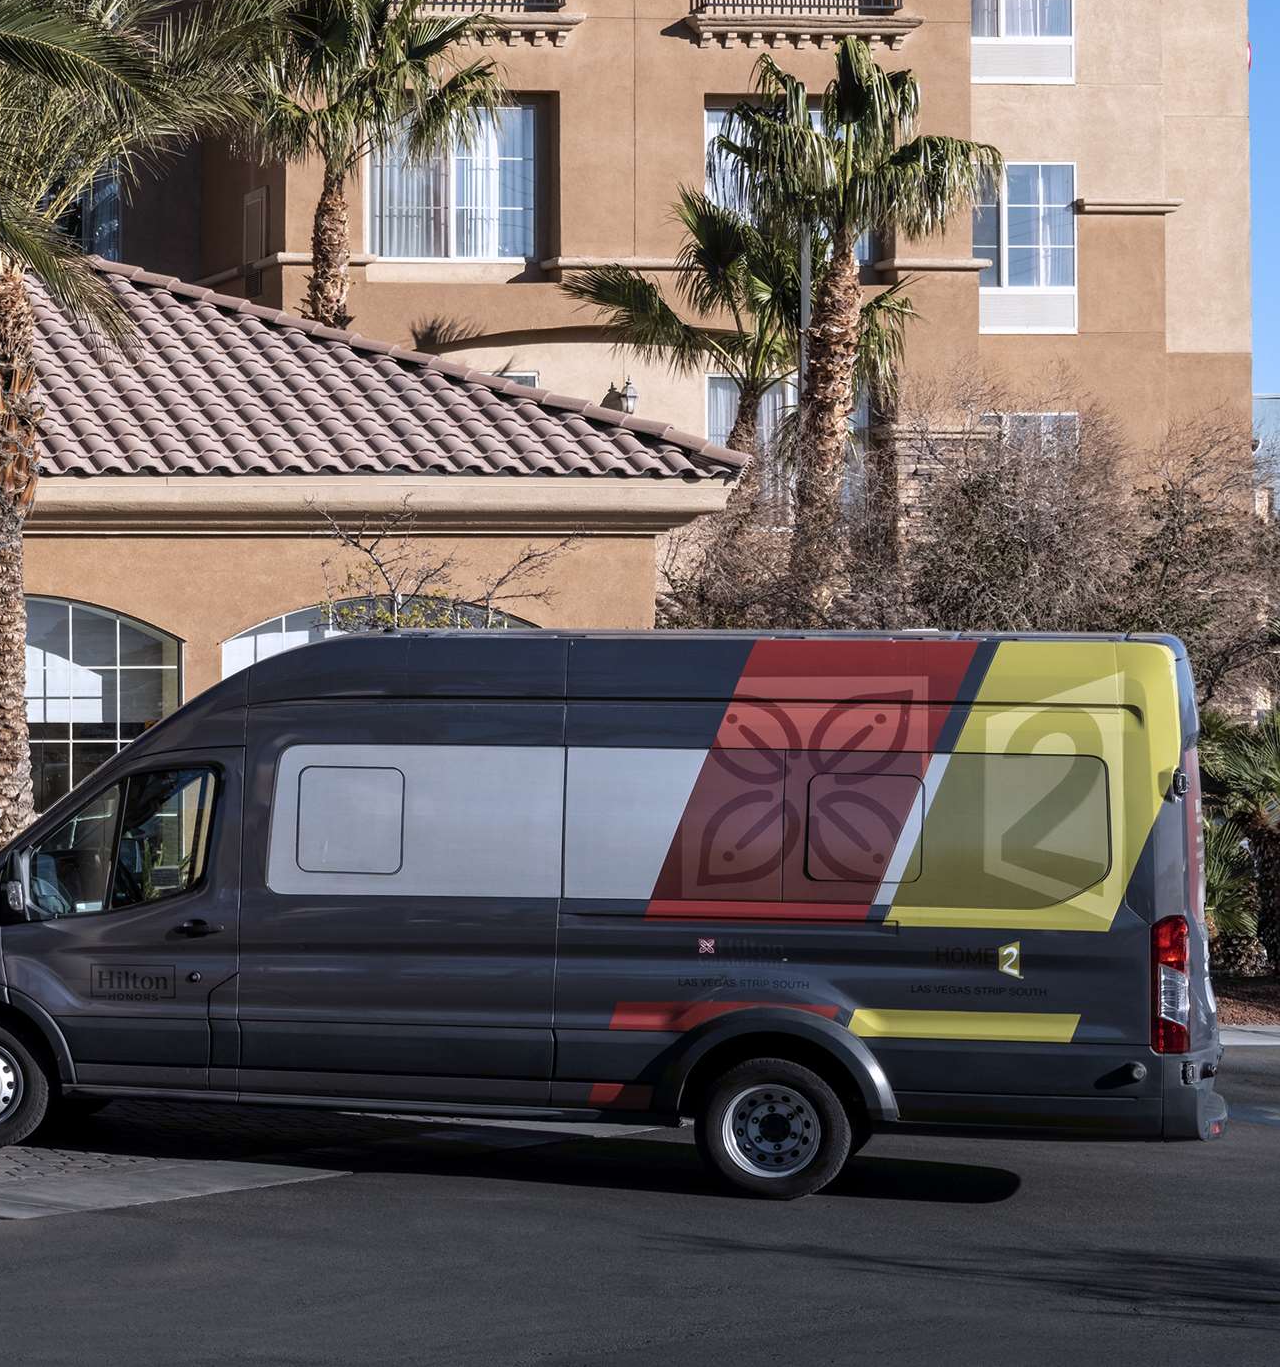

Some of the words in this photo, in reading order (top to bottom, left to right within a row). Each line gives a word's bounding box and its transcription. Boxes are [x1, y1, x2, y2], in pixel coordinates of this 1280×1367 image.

[97, 970, 168, 990] Hilton
[678, 978, 698, 986] LAS
[702, 978, 736, 988] VEGAS
[741, 979, 769, 988] STRIP
[772, 980, 810, 990] SOUTH
[911, 985, 931, 994] LAS
[935, 985, 971, 994] VEGAS
[975, 986, 1007, 995] STRIP
[1009, 987, 1048, 997] SOUTH
[107, 993, 159, 1002] HONORS
